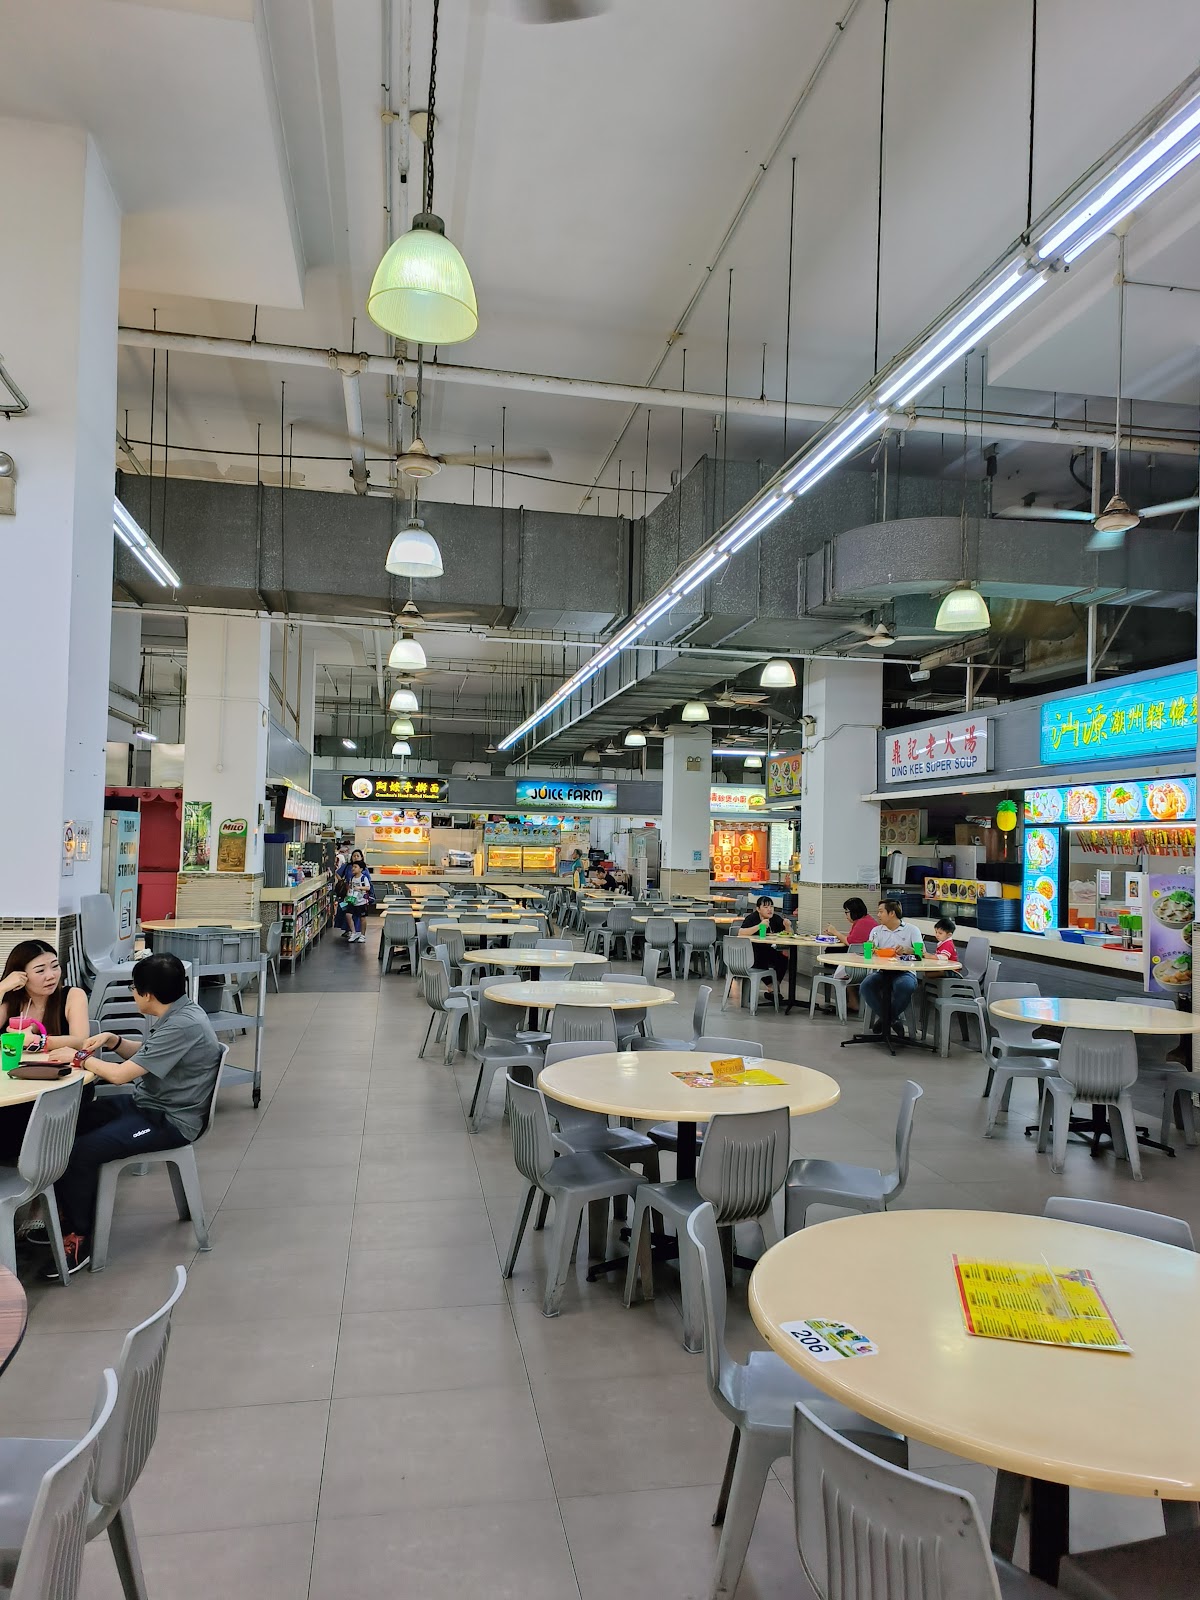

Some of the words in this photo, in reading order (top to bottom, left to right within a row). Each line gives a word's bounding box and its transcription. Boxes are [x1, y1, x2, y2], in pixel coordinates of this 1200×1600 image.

[891, 765, 908, 777] DING
[909, 762, 923, 775] KEE
[926, 759, 952, 773] SUPER
[954, 755, 978, 770] SOUP
[530, 788, 563, 800] JUICE
[567, 788, 603, 802] FARM
[222, 823, 244, 831] MILO
[118, 863, 136, 876] STATION
[132, 1128, 151, 1138] adidas
[790, 1329, 830, 1353] 206
